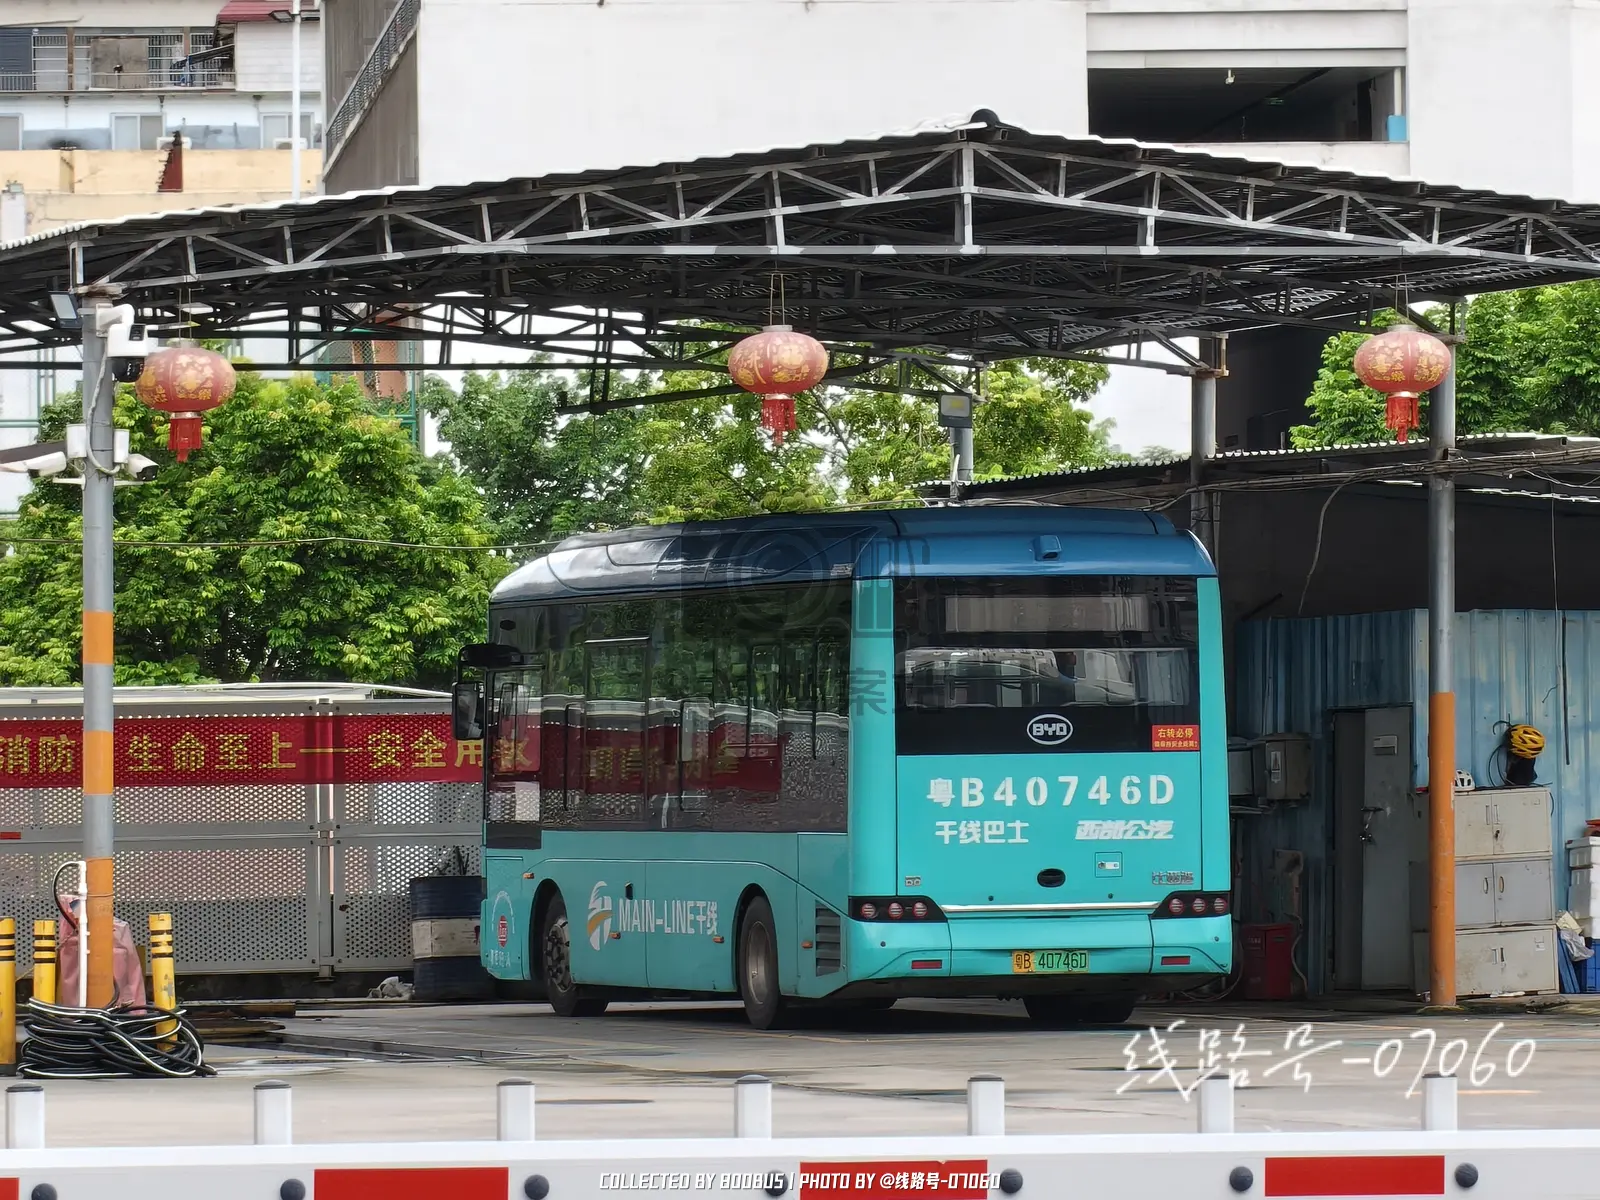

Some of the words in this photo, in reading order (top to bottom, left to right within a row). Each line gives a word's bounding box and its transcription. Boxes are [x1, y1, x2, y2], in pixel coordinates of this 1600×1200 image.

[1032, 723, 1067, 736] BYD
[1157, 727, 1194, 739] 右转必停
[926, 774, 1174, 807] 粤B40746D
[935, 819, 1030, 845] 干线巴士
[1075, 819, 1175, 841] 西部公汽
